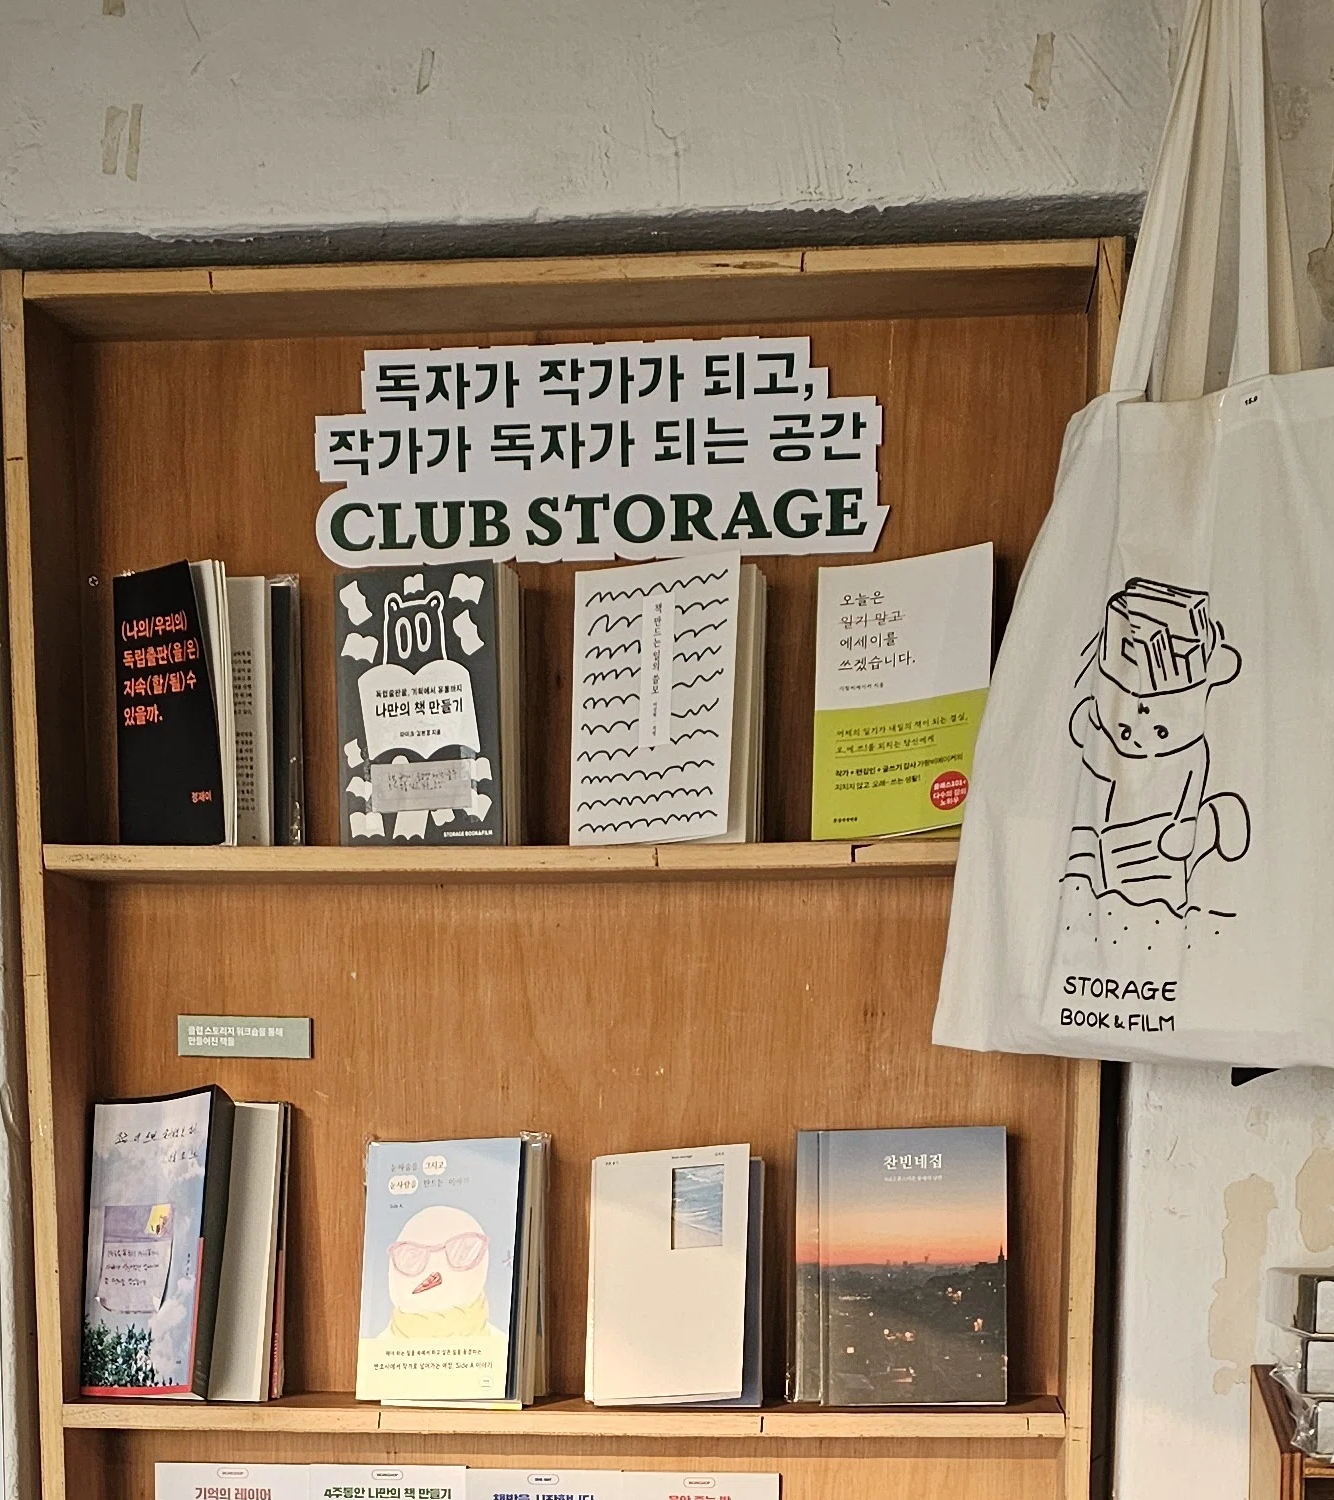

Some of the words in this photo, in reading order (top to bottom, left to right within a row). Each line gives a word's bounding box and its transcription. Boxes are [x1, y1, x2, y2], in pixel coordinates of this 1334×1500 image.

[375, 361, 520, 411] 독자가
[538, 354, 684, 406] 작가가
[703, 352, 814, 402] 되고,
[328, 424, 472, 476] 작가가
[490, 418, 635, 470] 독자가
[654, 414, 749, 466] 되는
[769, 410, 867, 462] 공간
[330, 499, 510, 551] CLUB
[527, 487, 867, 547] STORAGE
[840, 590, 884, 606] 오늘은
[121, 610, 187, 642] (나의/우리의)
[840, 632, 897, 650] 에세이를
[123, 637, 200, 669] 독립출판(을/은)
[838, 650, 916, 672] 쓰겠습니다.
[186, 670, 197, 688] 수
[124, 705, 163, 726] 있을까.
[376, 702, 410, 718] 나만의
[414, 701, 426, 715] 책
[429, 697, 463, 713] 만들기
[1063, 976, 1177, 1002] STORAGE
[188, 1025, 203, 1037] 클럽
[204, 1025, 235, 1037] 스토리지
[883, 1153, 943, 1170] 찬빈네집
[195, 1487, 230, 1500] 기억의
[235, 1487, 272, 1500] 레이어
[368, 1487, 400, 1499] 나만의
[404, 1488, 415, 1499] 책
[418, 1488, 451, 1500] 만들기
